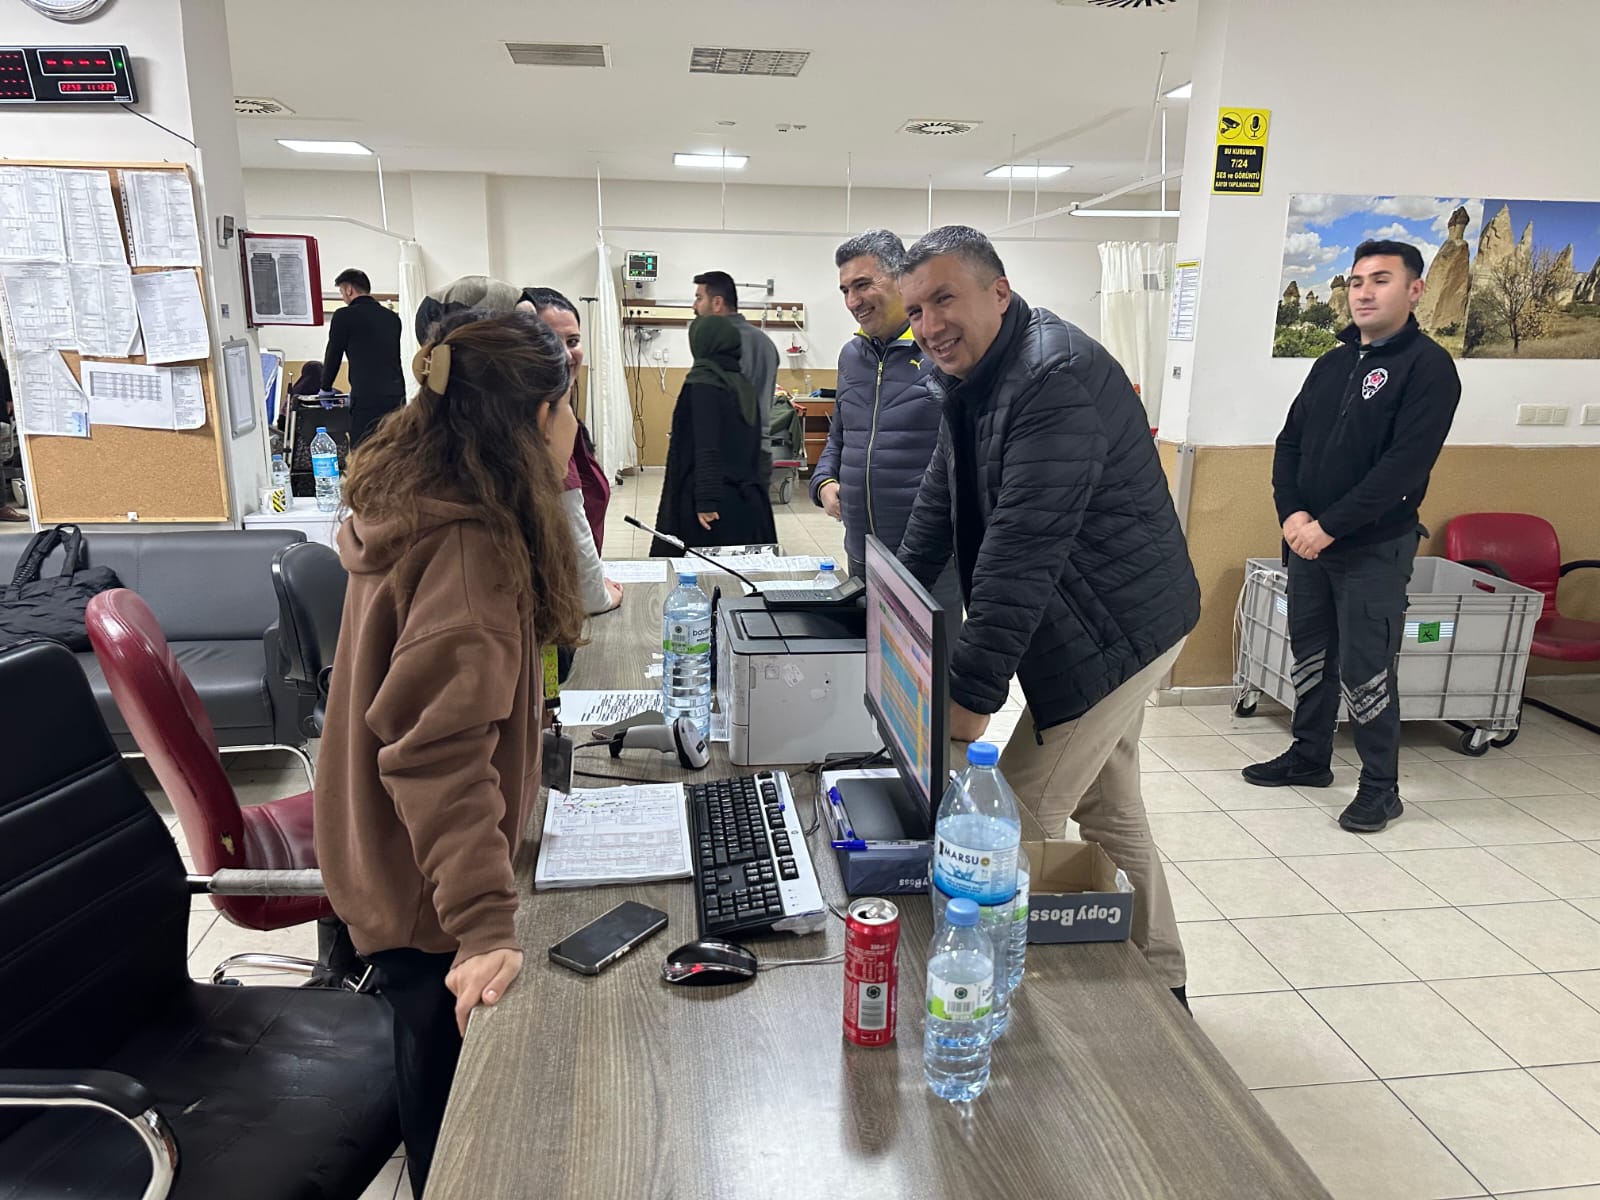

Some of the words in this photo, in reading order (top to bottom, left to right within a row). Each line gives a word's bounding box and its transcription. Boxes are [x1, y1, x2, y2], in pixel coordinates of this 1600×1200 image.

[1231, 159, 1248, 168] 7/24
[944, 847, 980, 865] MARSU
[898, 878, 922, 889] Boss
[1030, 909, 1075, 926] Boss
[1076, 905, 1122, 924] Copy
